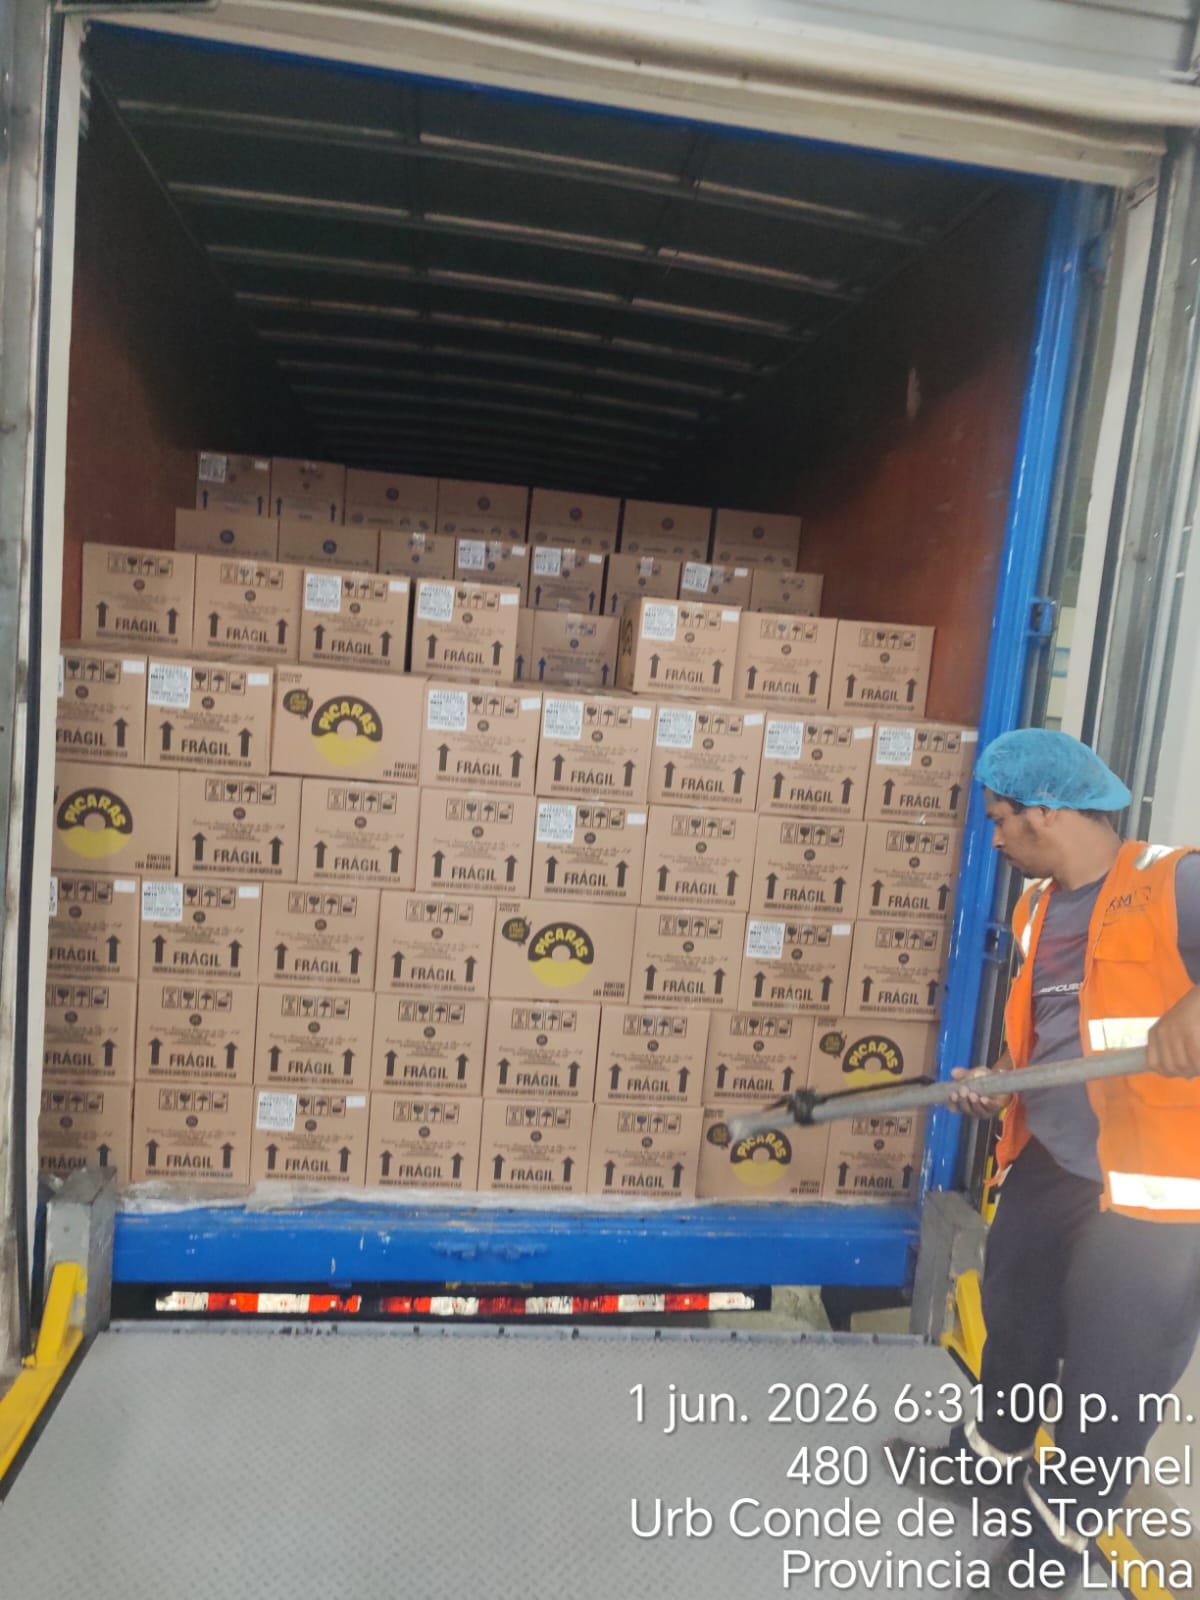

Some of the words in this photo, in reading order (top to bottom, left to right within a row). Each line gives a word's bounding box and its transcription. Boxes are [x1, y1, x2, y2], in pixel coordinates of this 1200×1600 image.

[115, 616, 159, 634] FRÁGIL
[226, 626, 269, 644] FRÁGIL
[331, 638, 373, 657] FRÁGIL
[443, 648, 485, 665] FRÁGIL
[664, 666, 704, 684] FRÁGIL
[762, 679, 800, 696] FRÁGIL
[861, 686, 898, 702] FRÁGIL
[318, 701, 377, 735] PICARAS
[56, 727, 106, 747] FRÁGIL
[180, 737, 231, 758] FRÁGIL
[456, 758, 502, 778] FRÁGIL
[570, 767, 615, 787] FRÁGIL
[681, 775, 725, 794] FRÁGIL
[790, 786, 832, 805] FRÁGIL
[900, 792, 942, 810] FRÁGIL
[64, 793, 126, 827] PICARAS
[213, 846, 262, 866] FRÁGIL
[334, 855, 381, 873] FRÁGIL
[452, 863, 498, 882] FRÁGIL
[564, 870, 608, 888] FRÁGIL
[674, 878, 718, 897] FRÁGIL
[783, 886, 826, 904] FRÁGIL
[888, 893, 930, 910] FRÁGIL
[535, 927, 588, 957] PICARAS
[49, 945, 100, 964] FRÁGIL
[173, 950, 221, 968] FRÁGIL
[294, 957, 342, 975] FRÁGIL
[410, 965, 456, 983] FRÁGIL
[662, 978, 706, 995] FRÁGIL
[770, 984, 813, 1002] FRÁGIL
[878, 989, 919, 1006] FRÁGIL
[44, 1050, 95, 1068] FRÁGIL
[169, 1052, 218, 1070] FRÁGIL
[849, 1040, 898, 1068] PICARAS
[287, 1058, 334, 1076] FRÁGIL
[402, 1062, 449, 1080] FRÁGIL
[516, 1070, 561, 1090] FRÁGIL
[626, 1076, 672, 1094] FRÁGIL
[732, 1076, 775, 1093] FRÁGIL
[736, 1132, 786, 1158] PICARAS
[166, 1150, 214, 1170] FRÁGIL
[284, 1156, 330, 1174] FRÁGIL
[398, 1162, 444, 1180] FRÁGIL
[510, 1165, 556, 1183] FRÁGIL
[621, 1171, 665, 1189] FRÁGIL
[854, 1172, 896, 1189] FRÁGIL
